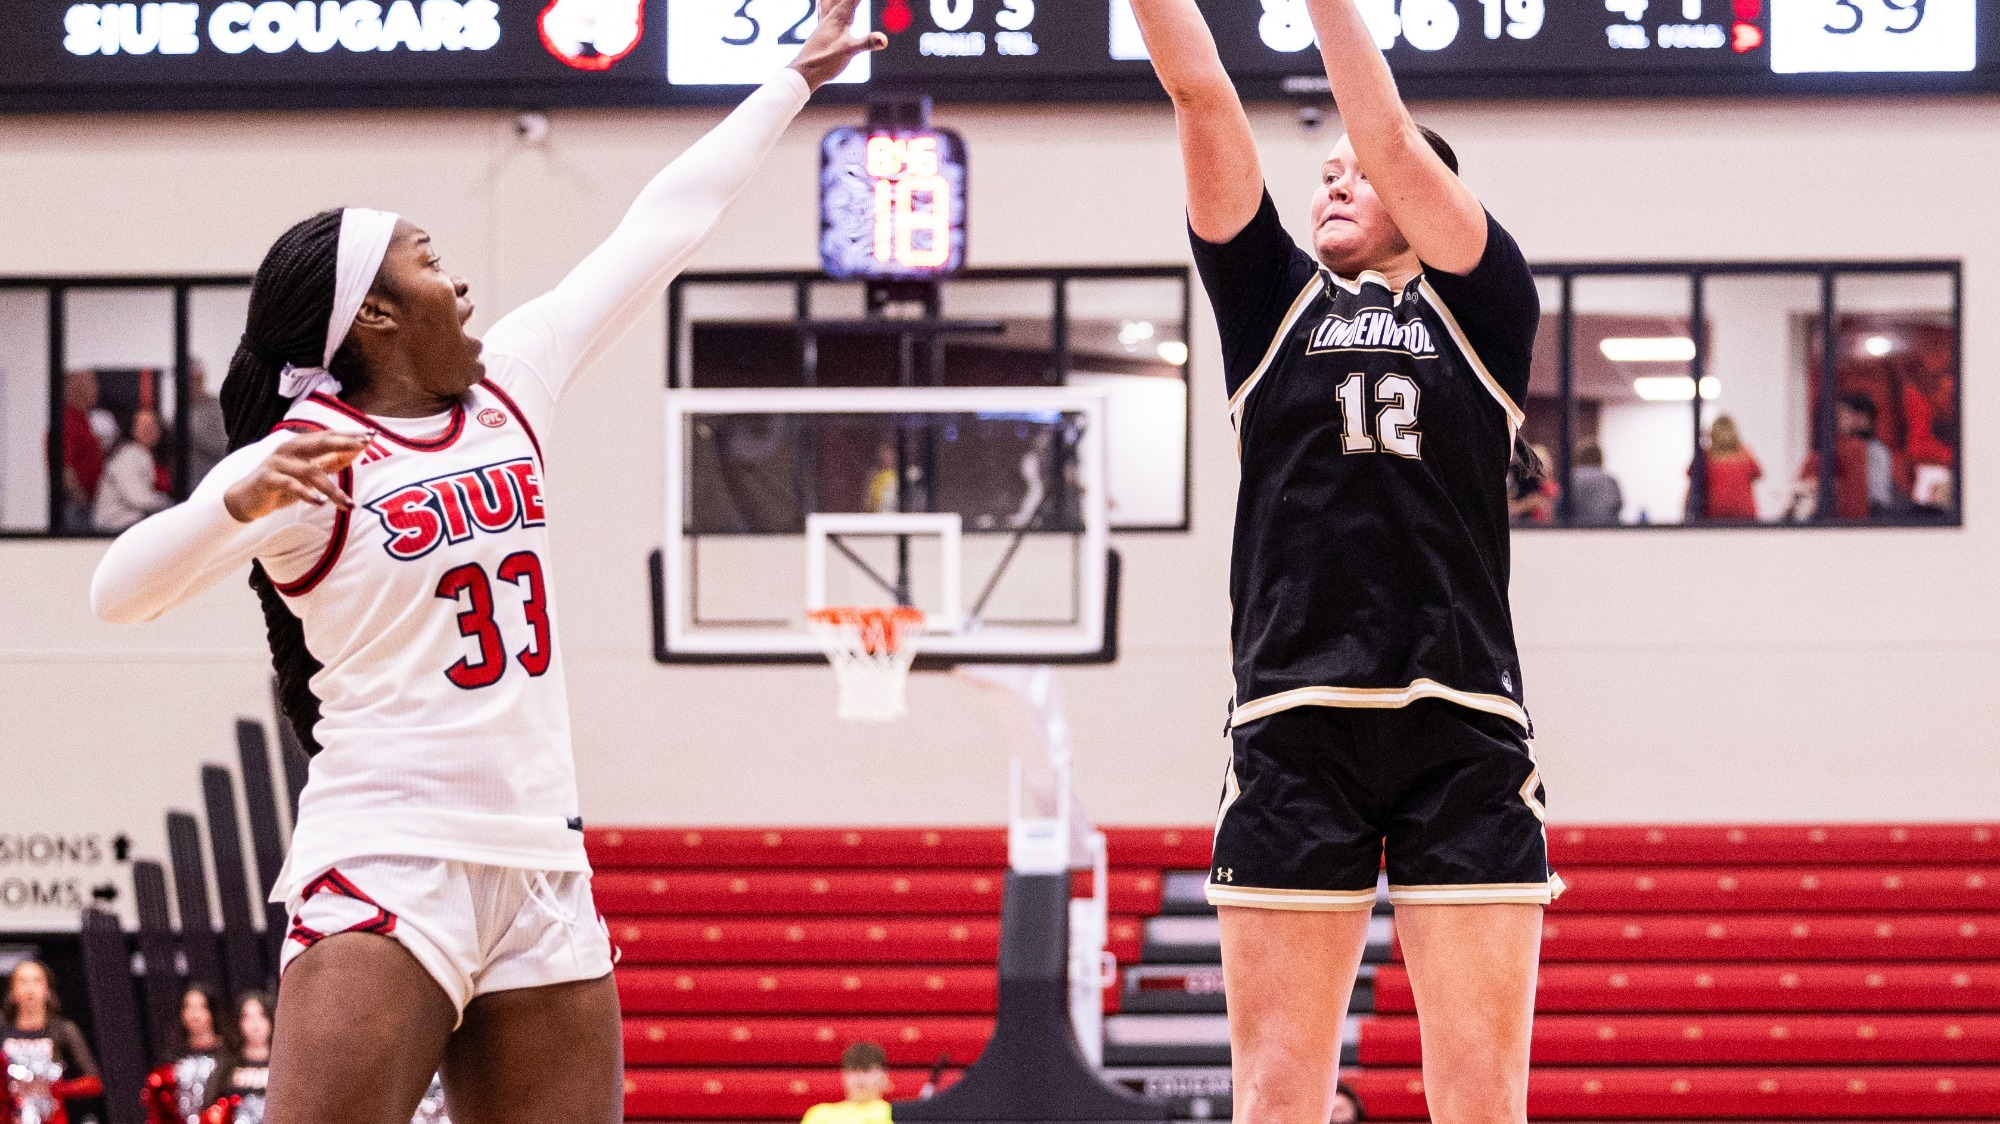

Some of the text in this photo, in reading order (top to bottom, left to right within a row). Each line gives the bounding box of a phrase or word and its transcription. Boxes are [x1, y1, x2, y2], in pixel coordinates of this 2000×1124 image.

[64, 1, 501, 55] SIUE COUGARS
[874, 175, 950, 267] 18
[1336, 372, 1423, 461] 12
[362, 457, 547, 562] SIUE
[434, 550, 552, 690] 33
